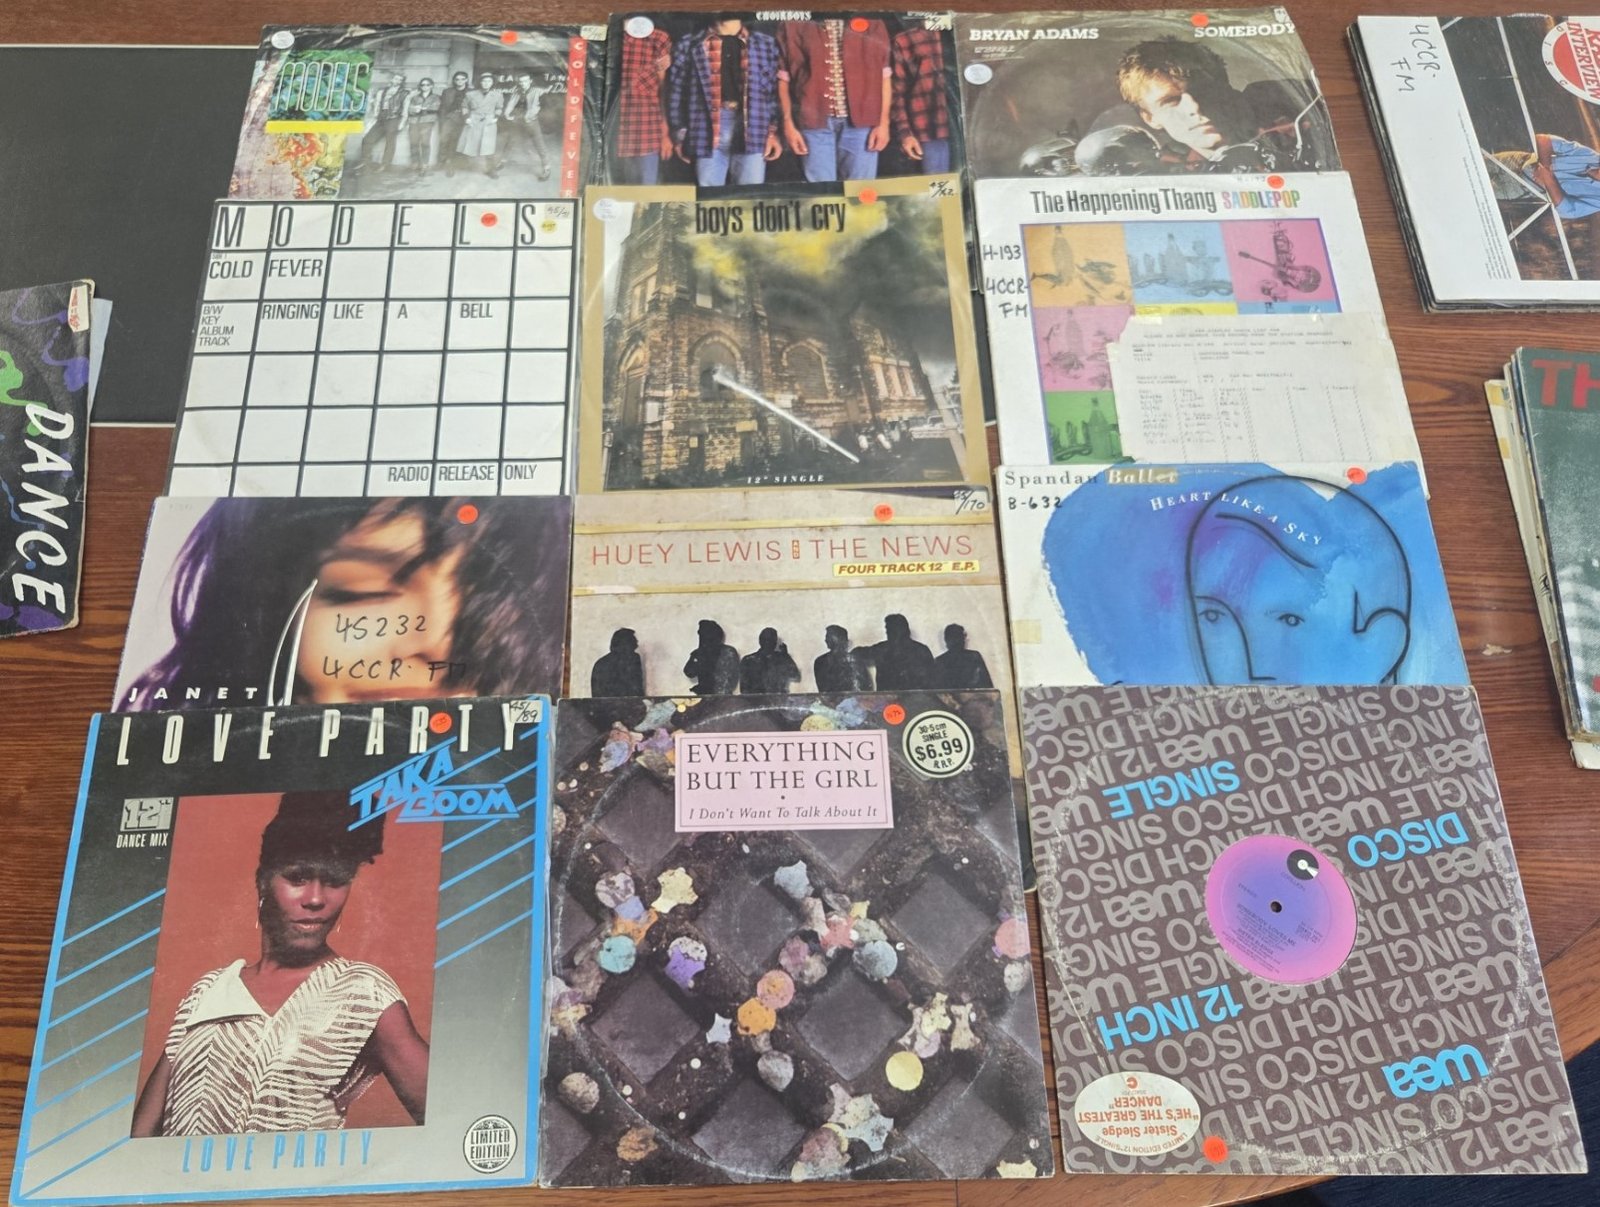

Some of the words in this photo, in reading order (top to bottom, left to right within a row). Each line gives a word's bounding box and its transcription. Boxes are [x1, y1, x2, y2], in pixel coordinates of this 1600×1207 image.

[969, 29, 1030, 41] BRYAN
[1032, 28, 1099, 40] ADAMS
[1194, 23, 1295, 38] SOMEBODY
[274, 60, 371, 113] MODELS
[696, 202, 743, 234] boys
[752, 201, 800, 232] don't
[811, 205, 846, 232] cry
[1030, 191, 1064, 214] The
[1066, 188, 1160, 216] Happening
[1160, 188, 1217, 214] Thang
[1221, 190, 1300, 209] SADDLEPOP
[209, 259, 253, 280] COLD
[268, 258, 323, 278] FEVER
[982, 244, 1022, 261] H-193
[202, 316, 219, 325] KEY
[204, 305, 223, 314] B/W
[262, 303, 320, 320] RINGING
[333, 303, 364, 319] LIKE
[398, 303, 408, 319] A
[460, 302, 493, 318] BELL
[999, 304, 1028, 318] FM
[199, 336, 230, 346] TRACK
[200, 326, 234, 336] ALBUM
[388, 466, 430, 482] RADIO
[438, 464, 495, 482] RELEASE
[504, 464, 537, 480] ONLY
[774, 475, 825, 484] SINGLE
[1004, 470, 1098, 489] Spandau
[1108, 469, 1178, 484] Ballet
[12, 402, 75, 615] DANCE
[1150, 492, 1211, 511] HEART
[1221, 493, 1264, 514] LIKE
[1268, 514, 1279, 524] A
[1284, 522, 1322, 545] SKY
[592, 543, 674, 566] HUEY
[688, 540, 781, 563] LEWIS
[808, 538, 867, 559] THE
[882, 535, 972, 557] NEWS
[838, 564, 876, 574] FOUR
[880, 562, 926, 574] TRACK
[952, 562, 976, 572] E.P.
[130, 687, 258, 702] JANET
[512, 701, 538, 722] 45/89
[116, 711, 276, 766] LOVE
[319, 703, 516, 757] PARTY
[922, 730, 948, 742] SINGLE
[1250, 689, 1388, 747] SINGLE
[1359, 707, 1456, 755] INCH
[686, 740, 876, 764] EVERYTHING
[914, 738, 963, 762] $6.99
[1113, 743, 1159, 779] 12
[1154, 722, 1252, 771] wea
[1239, 729, 1362, 785] DISCO
[352, 748, 455, 817] TAKA
[686, 771, 742, 792] BUT
[750, 770, 806, 790] THE
[815, 768, 878, 788] GIRL
[1290, 759, 1386, 809] INCH
[1382, 748, 1430, 785] 12
[402, 788, 519, 816] BOOM
[1100, 757, 1243, 820] SINGLE
[688, 808, 696, 820] I
[699, 807, 734, 820] Don't
[739, 808, 772, 819] Want
[776, 806, 790, 818] To
[794, 806, 821, 818] Talk
[824, 806, 863, 818] About
[866, 806, 878, 818] It
[1167, 782, 1291, 839] DISCO
[1291, 794, 1392, 846] wea
[116, 834, 146, 848] DANCE
[150, 832, 168, 847] MIX
[1342, 810, 1469, 870] DISCO
[1383, 857, 1432, 897] 12
[1100, 876, 1203, 930] wea
[1407, 876, 1509, 929] INCH
[1341, 919, 1491, 986] SINGLE
[1422, 948, 1529, 1004] wea
[1195, 980, 1246, 1024] 12
[1380, 973, 1431, 1016] 12
[1094, 993, 1199, 1051] INCH
[1280, 986, 1385, 1043] INCH
[1381, 999, 1487, 1057] INCH
[1149, 1011, 1282, 1077] DISCO
[1250, 1026, 1384, 1093] DISCO
[1380, 1040, 1490, 1100] wea
[1336, 1068, 1389, 1112] 12
[1423, 1064, 1559, 1132] DISCO
[1078, 1111, 1136, 1123] GREATEST
[1140, 1109, 1163, 1120] THE
[1234, 1080, 1341, 1140] INCH
[470, 1129, 510, 1144] LIMITED
[1102, 1125, 1140, 1137] Sledge
[1144, 1125, 1177, 1136] Sister
[1449, 1123, 1502, 1168] 12
[182, 1136, 254, 1172] LOVE
[273, 1131, 372, 1169] PARTY
[470, 1144, 510, 1159] EDITION
[1133, 1145, 1161, 1153] EDITION
